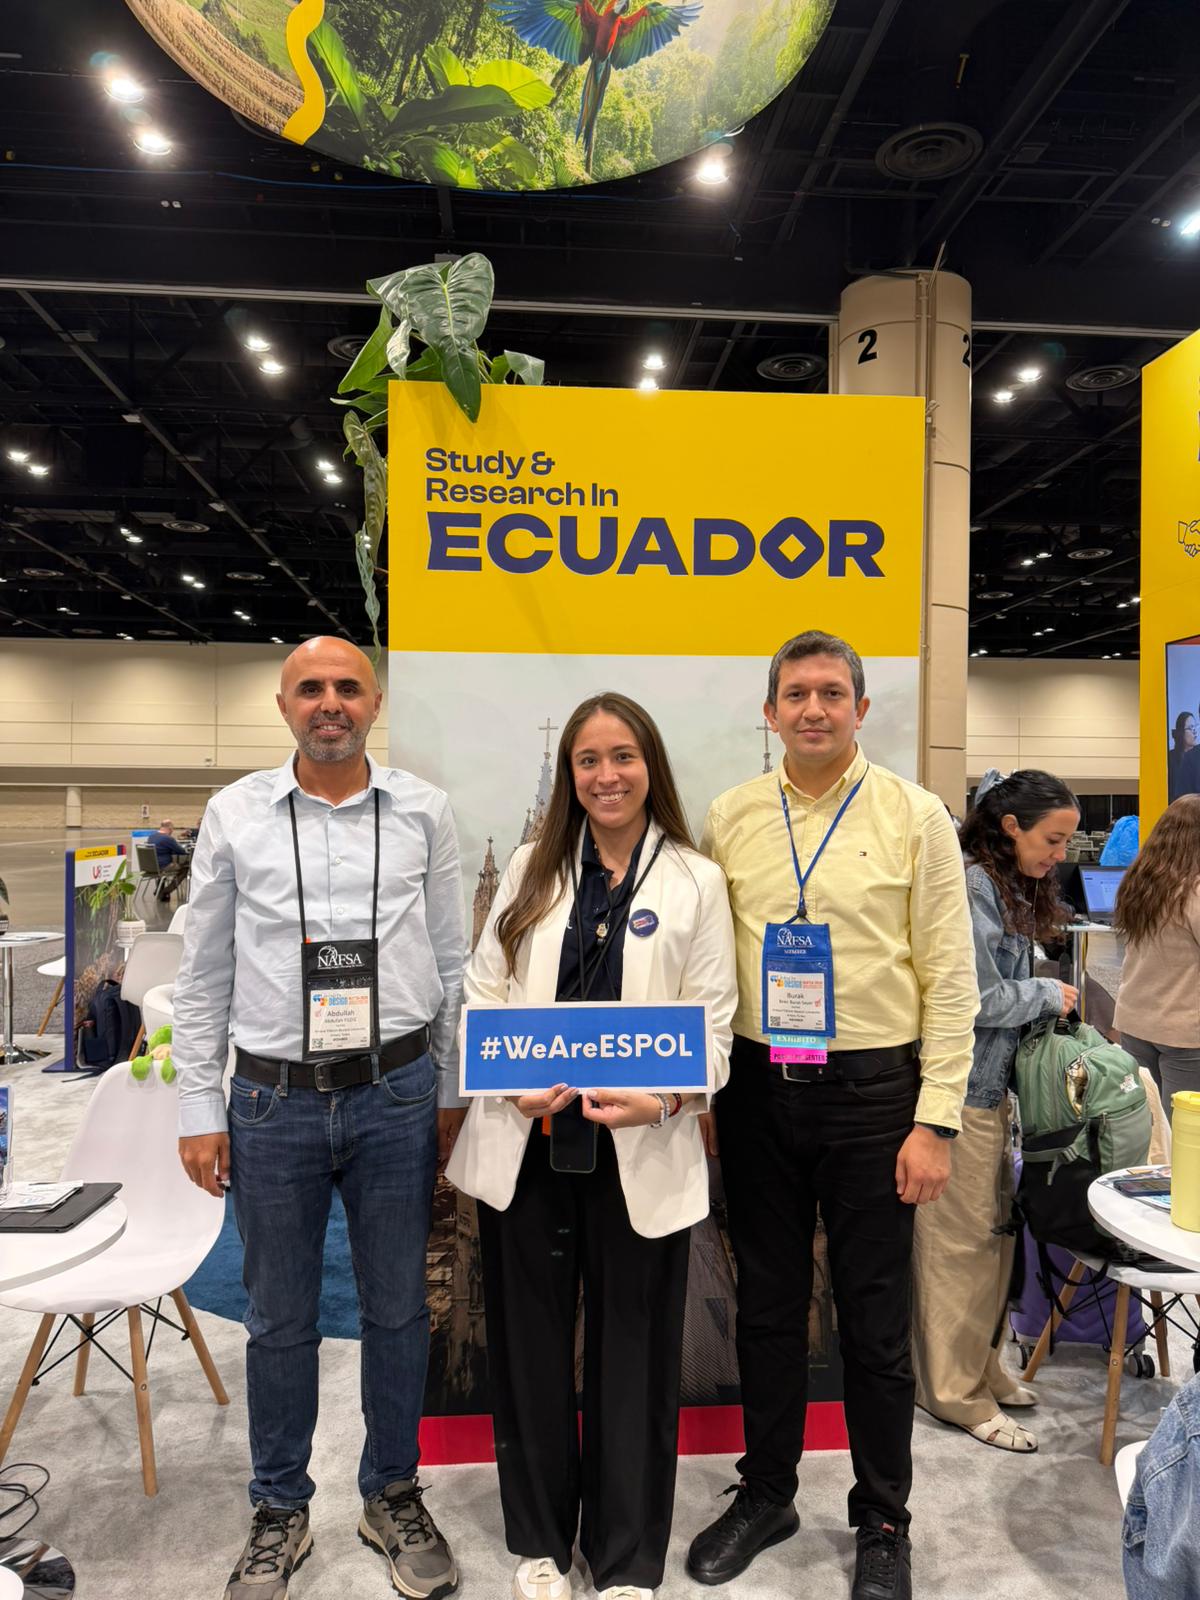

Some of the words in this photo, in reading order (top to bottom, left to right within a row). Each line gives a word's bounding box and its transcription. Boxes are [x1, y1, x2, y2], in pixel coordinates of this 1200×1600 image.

[858, 329, 878, 365] 2
[425, 447, 526, 480] Study
[530, 451, 556, 476] &
[426, 477, 586, 506] Research
[591, 483, 619, 507] In
[427, 511, 886, 580] ECUADOR
[777, 934, 813, 946] NAFSA
[317, 953, 362, 967] NAFSA
[327, 1009, 355, 1017] Abdullah
[480, 1033, 693, 1061] #WeAreESPOL
